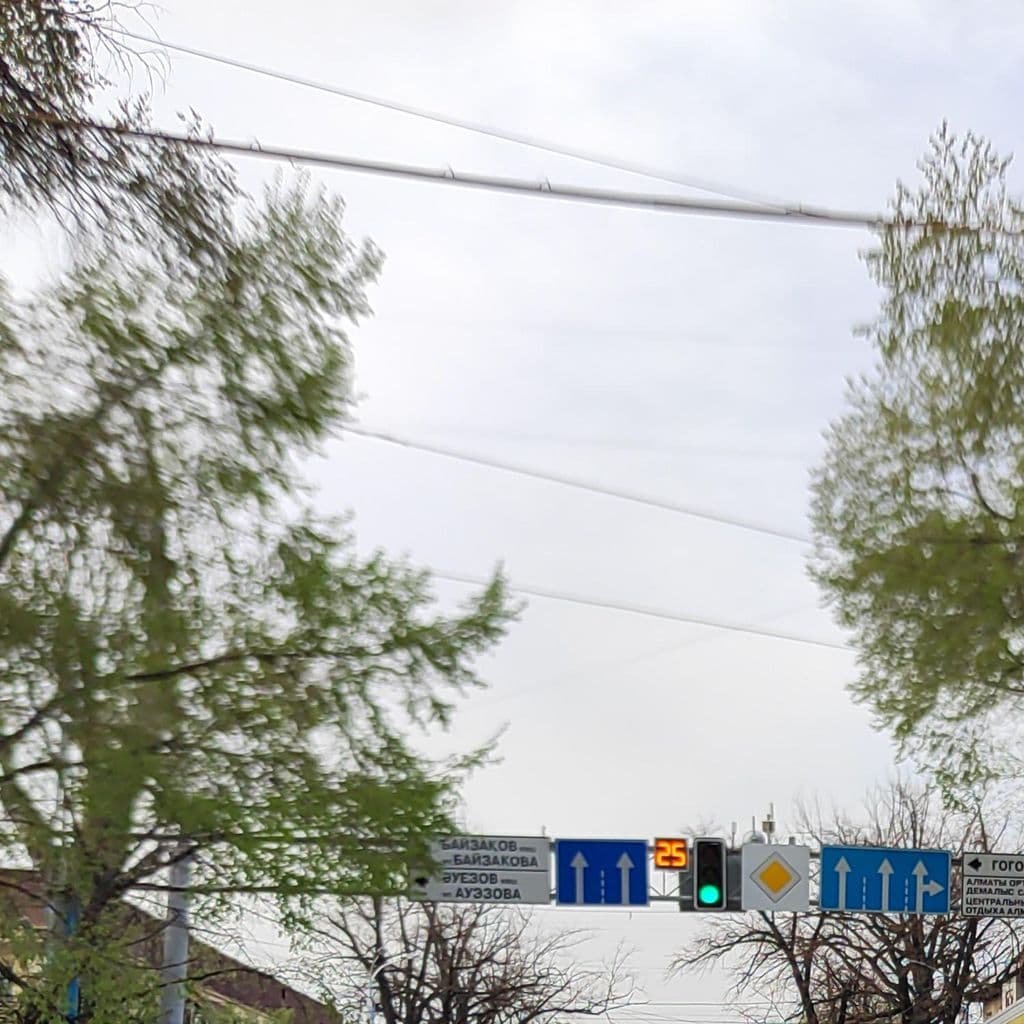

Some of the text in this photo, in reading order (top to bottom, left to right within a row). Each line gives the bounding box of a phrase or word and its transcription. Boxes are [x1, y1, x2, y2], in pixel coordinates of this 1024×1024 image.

[453, 853, 538, 867] БАЙЗАКОВА
[656, 840, 686, 867] 25
[966, 878, 1007, 887] АЛМАТЫ
[455, 887, 522, 900] АУЭЗОВА
[966, 907, 1005, 916] ОТДЫХА
